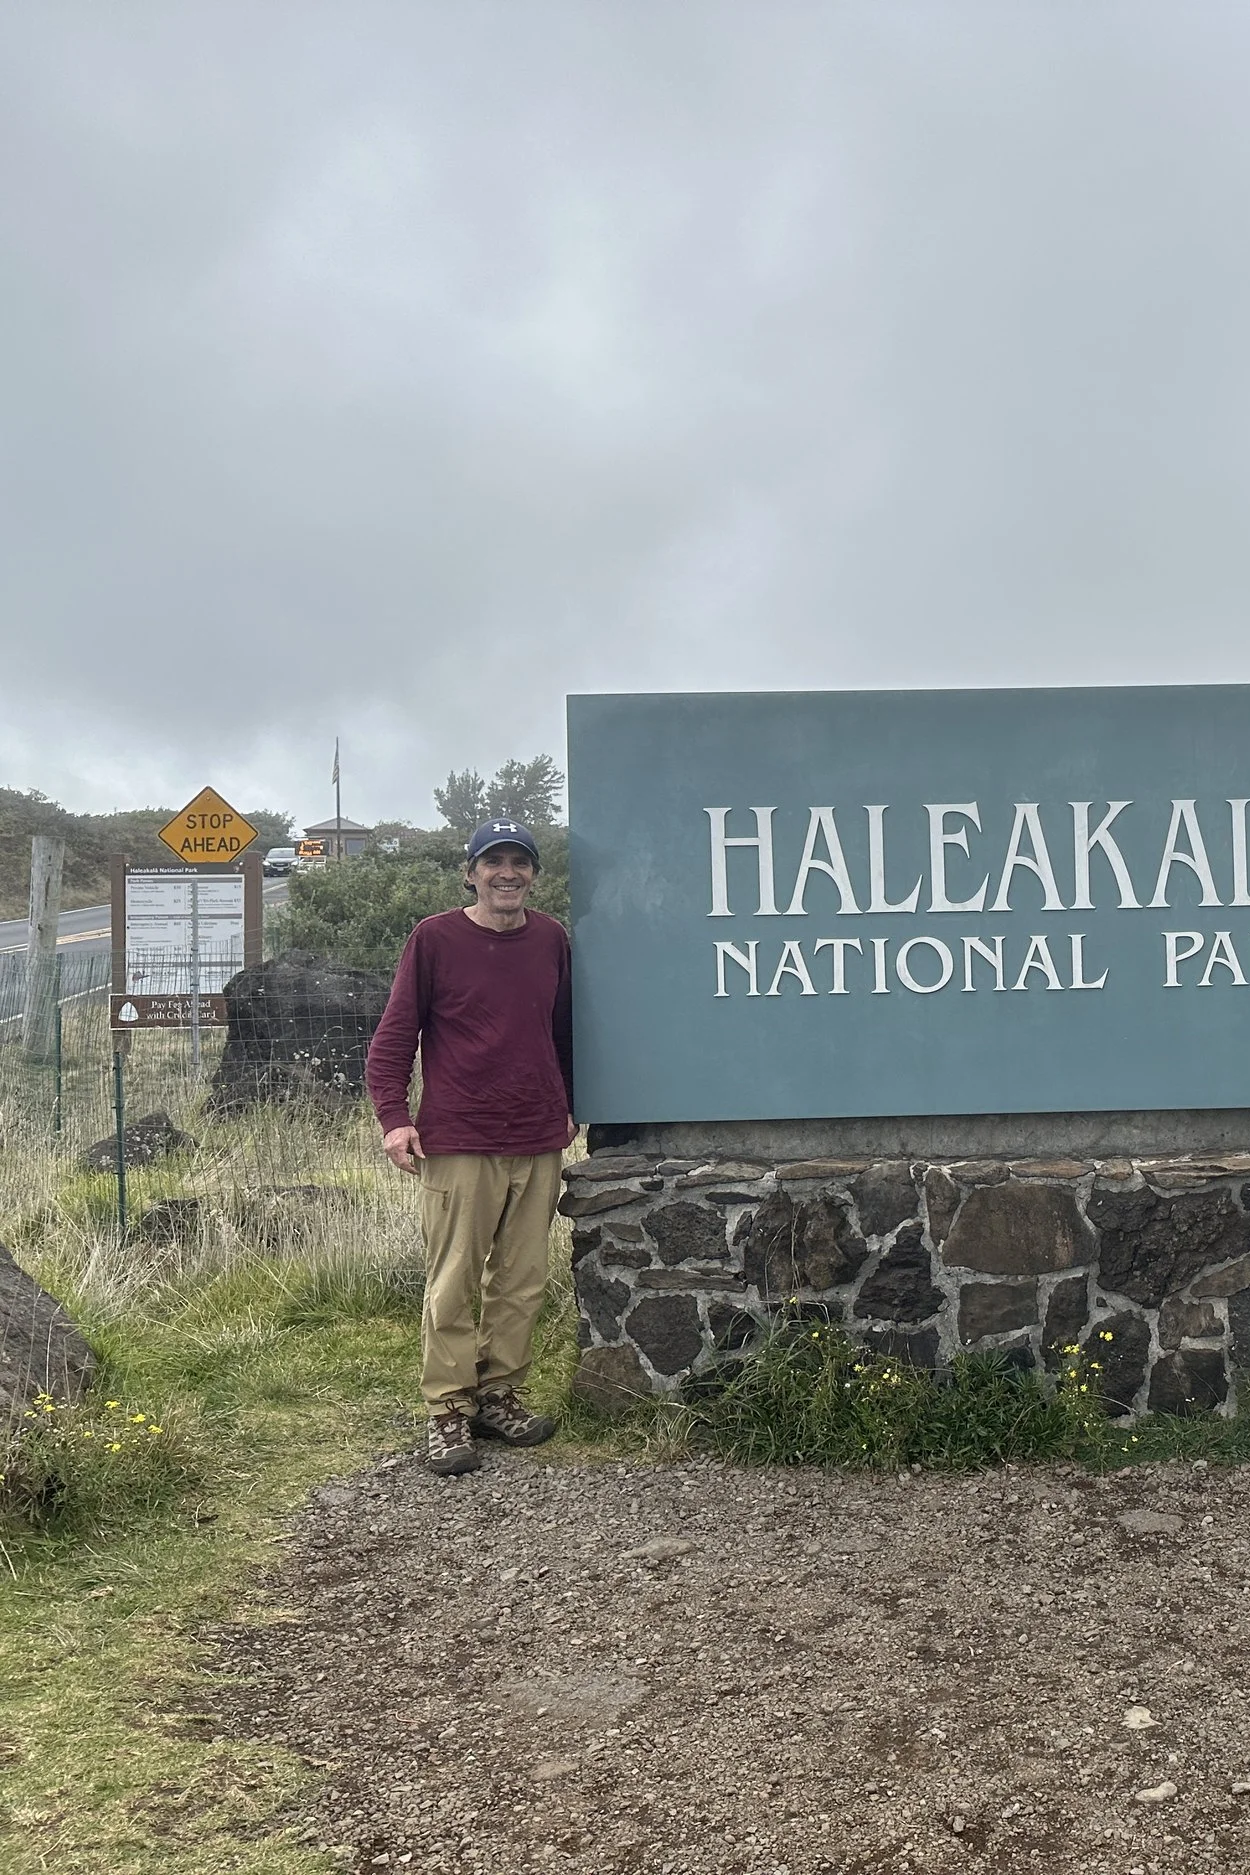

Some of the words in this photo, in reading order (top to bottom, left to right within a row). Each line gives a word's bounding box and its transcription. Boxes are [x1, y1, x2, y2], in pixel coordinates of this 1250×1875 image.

[186, 814, 233, 829] STOP
[180, 837, 240, 852] AHEAD
[712, 932, 1109, 998] NATIONAL
[151, 1001, 165, 1010] Pay
[146, 1011, 165, 1019] with
